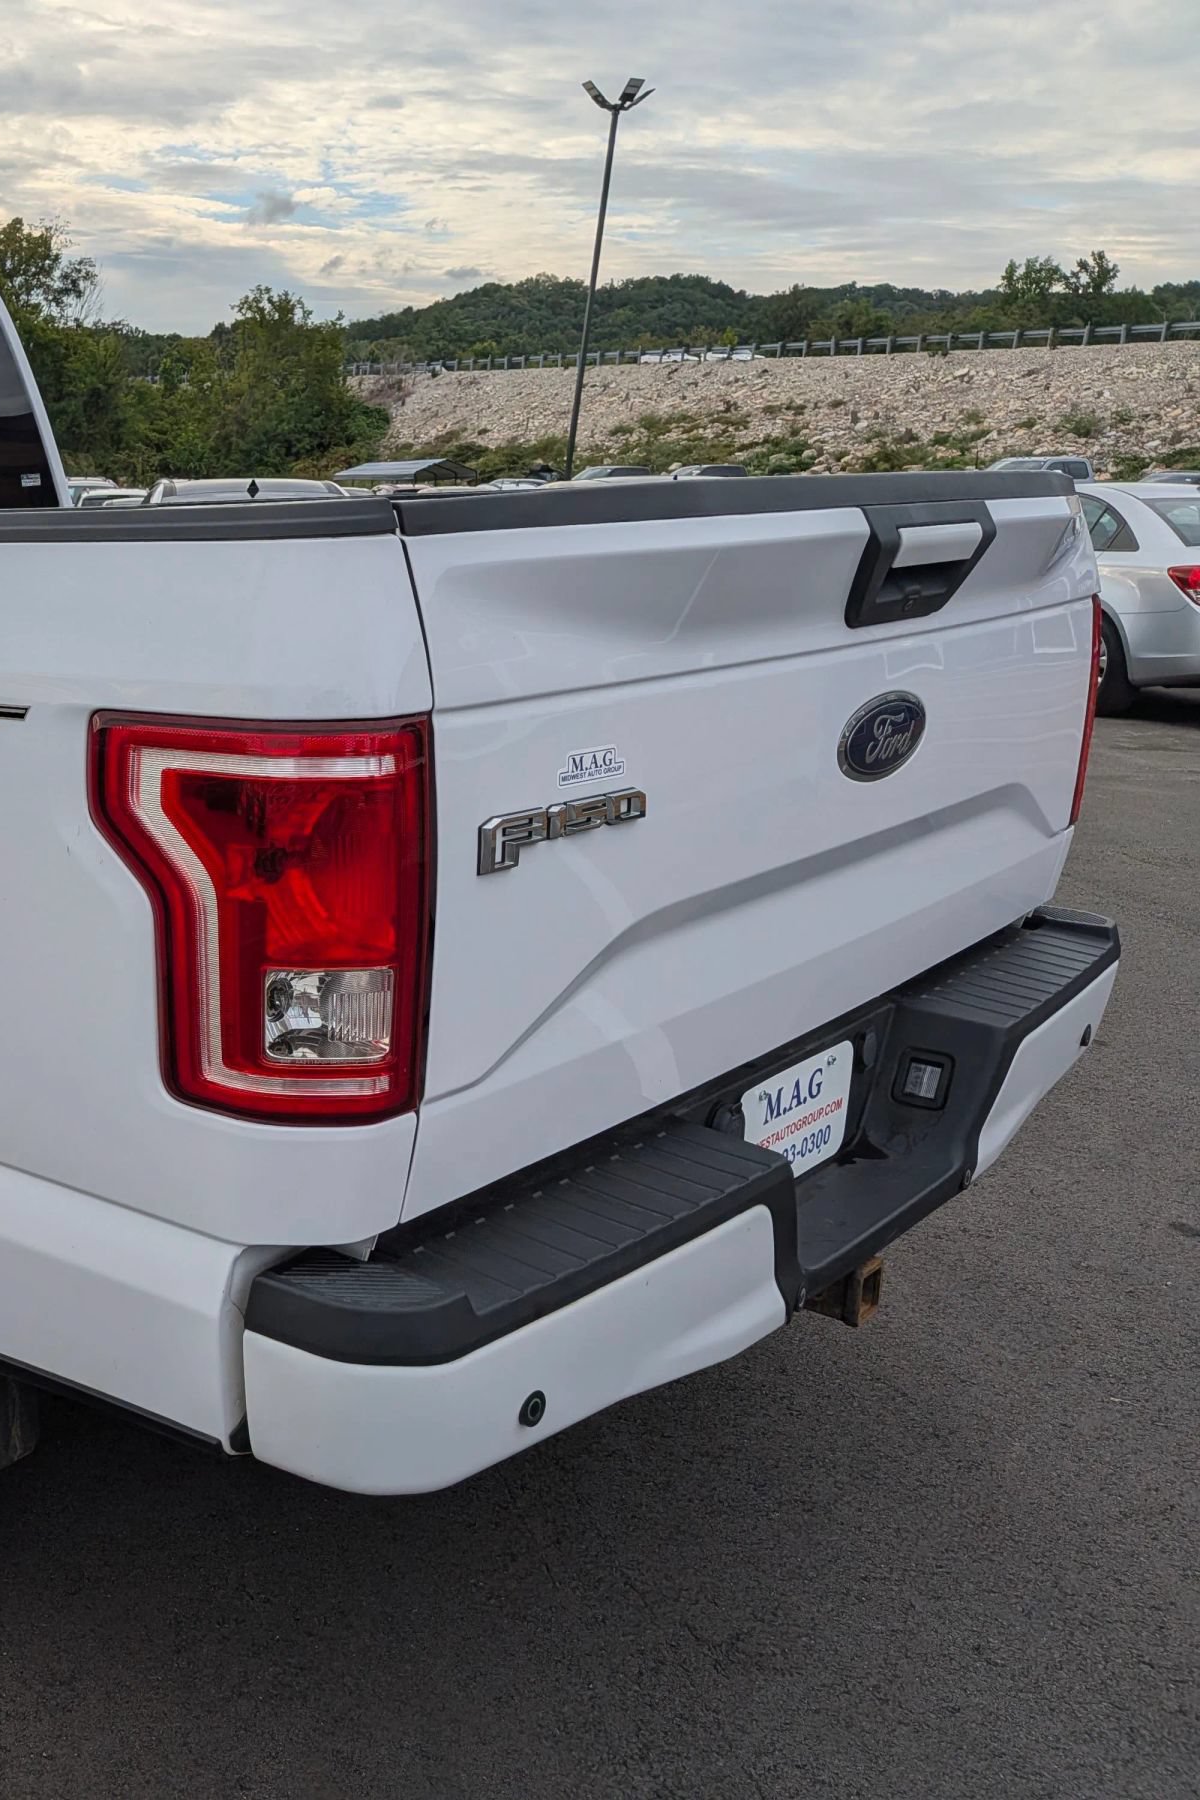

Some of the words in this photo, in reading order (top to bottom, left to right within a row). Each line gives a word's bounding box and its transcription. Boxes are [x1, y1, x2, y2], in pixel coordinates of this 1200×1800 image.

[865, 712, 915, 764] Ford
[561, 771, 587, 782] MIDWEST
[588, 769, 603, 777] AUTO
[603, 765, 622, 775] GROUP
[571, 751, 613, 773] M.A.G
[763, 1067, 824, 1125] M.A.G
